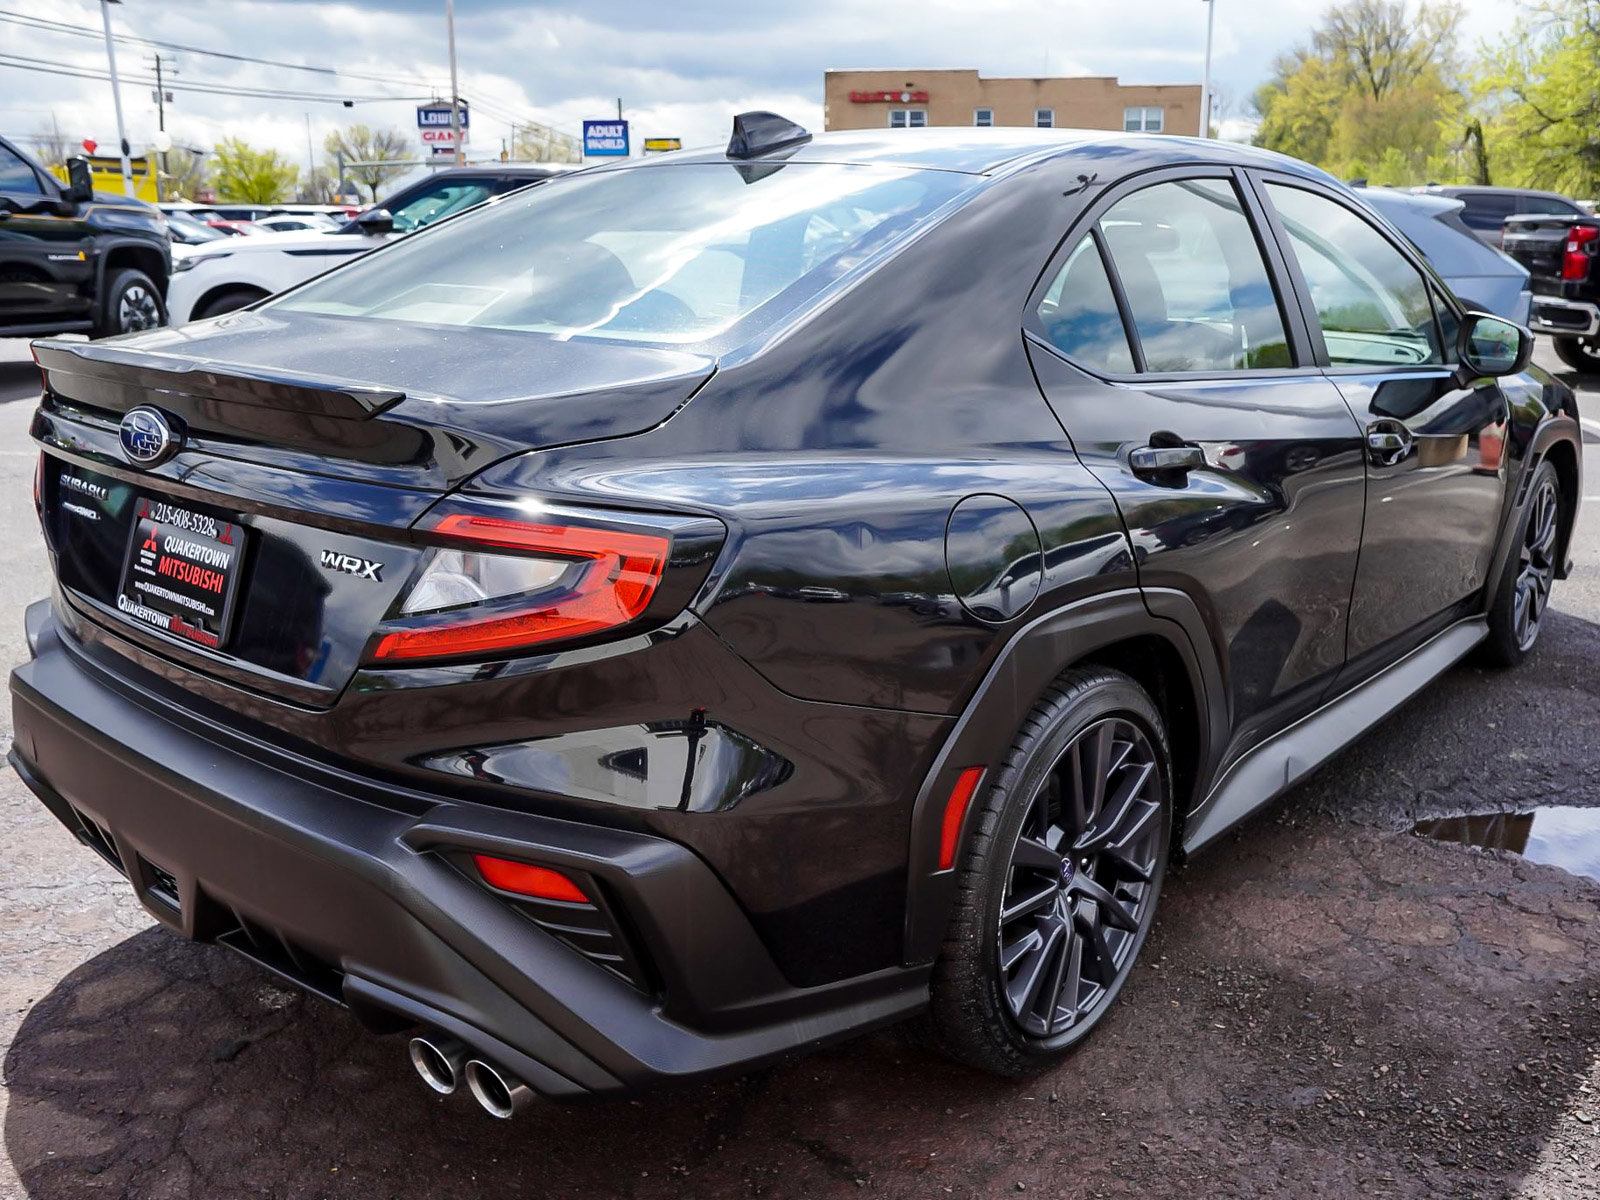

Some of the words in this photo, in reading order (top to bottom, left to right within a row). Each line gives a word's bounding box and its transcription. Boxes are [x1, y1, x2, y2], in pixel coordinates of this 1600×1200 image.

[420, 110, 466, 125] LOWS
[587, 125, 624, 137] ADULT
[154, 502, 215, 537] 215-608-5328
[164, 535, 230, 570] QUAKERTOWN
[320, 549, 385, 583] WRX
[158, 555, 224, 594] MITSUBISHI
[117, 593, 170, 629] QUAKERTOWN
